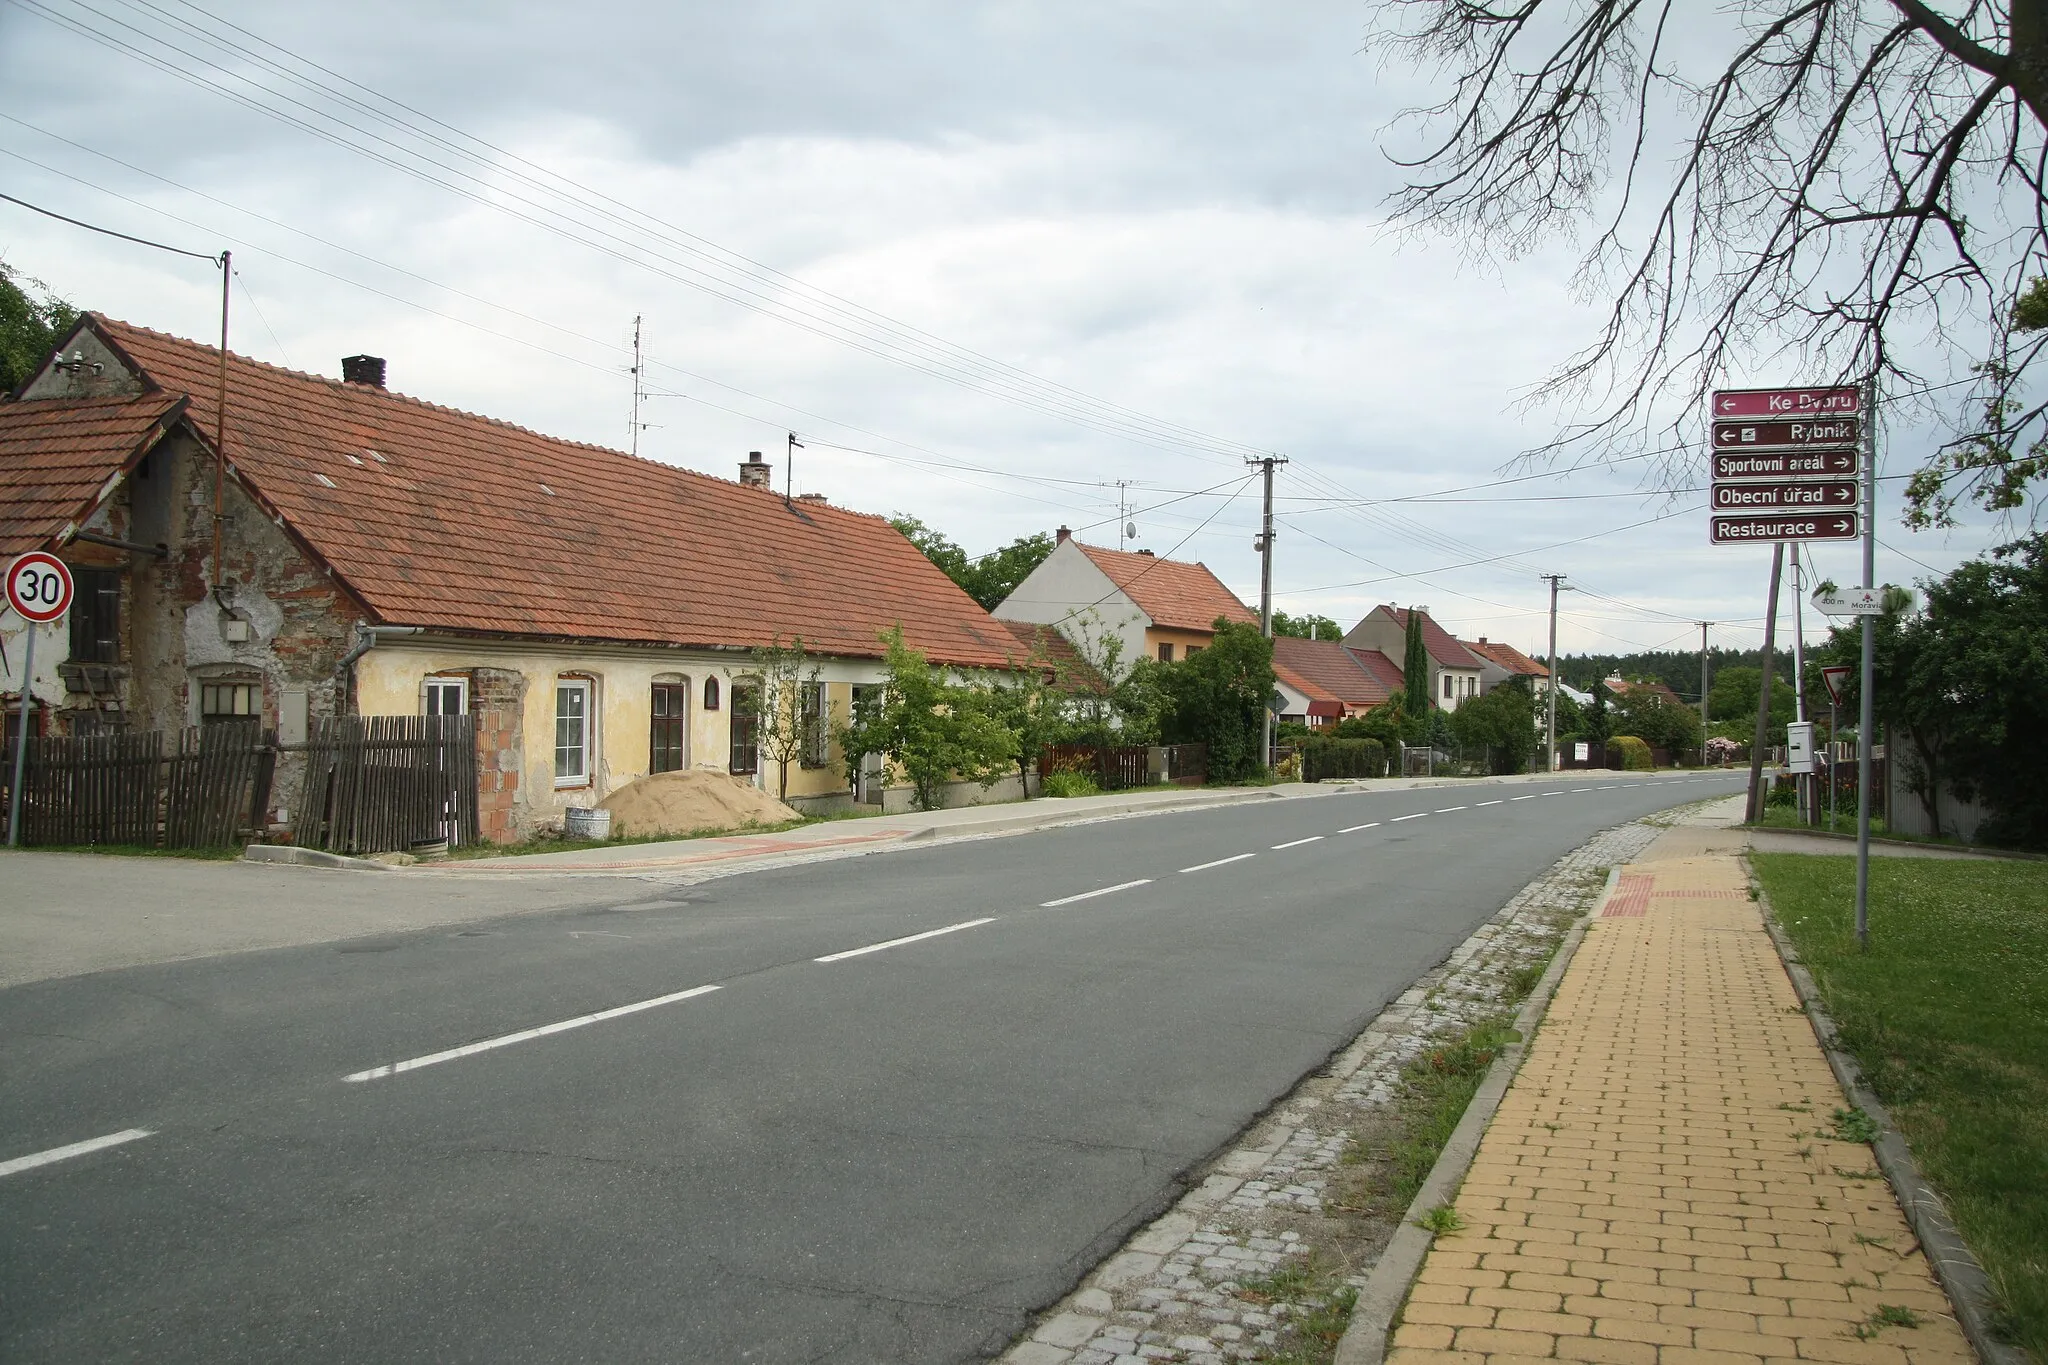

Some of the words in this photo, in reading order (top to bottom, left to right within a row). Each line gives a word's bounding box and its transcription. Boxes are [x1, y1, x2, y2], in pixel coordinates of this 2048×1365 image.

[1769, 395, 1791, 410] Ke
[1791, 422, 1850, 442] Rybník
[1719, 456, 1783, 476] Sportovní
[1790, 455, 1824, 470] areál
[1719, 488, 1778, 504] Obecní
[1784, 487, 1823, 503] úřad
[1718, 522, 1815, 537] Restaurace
[20, 570, 60, 604] 30
